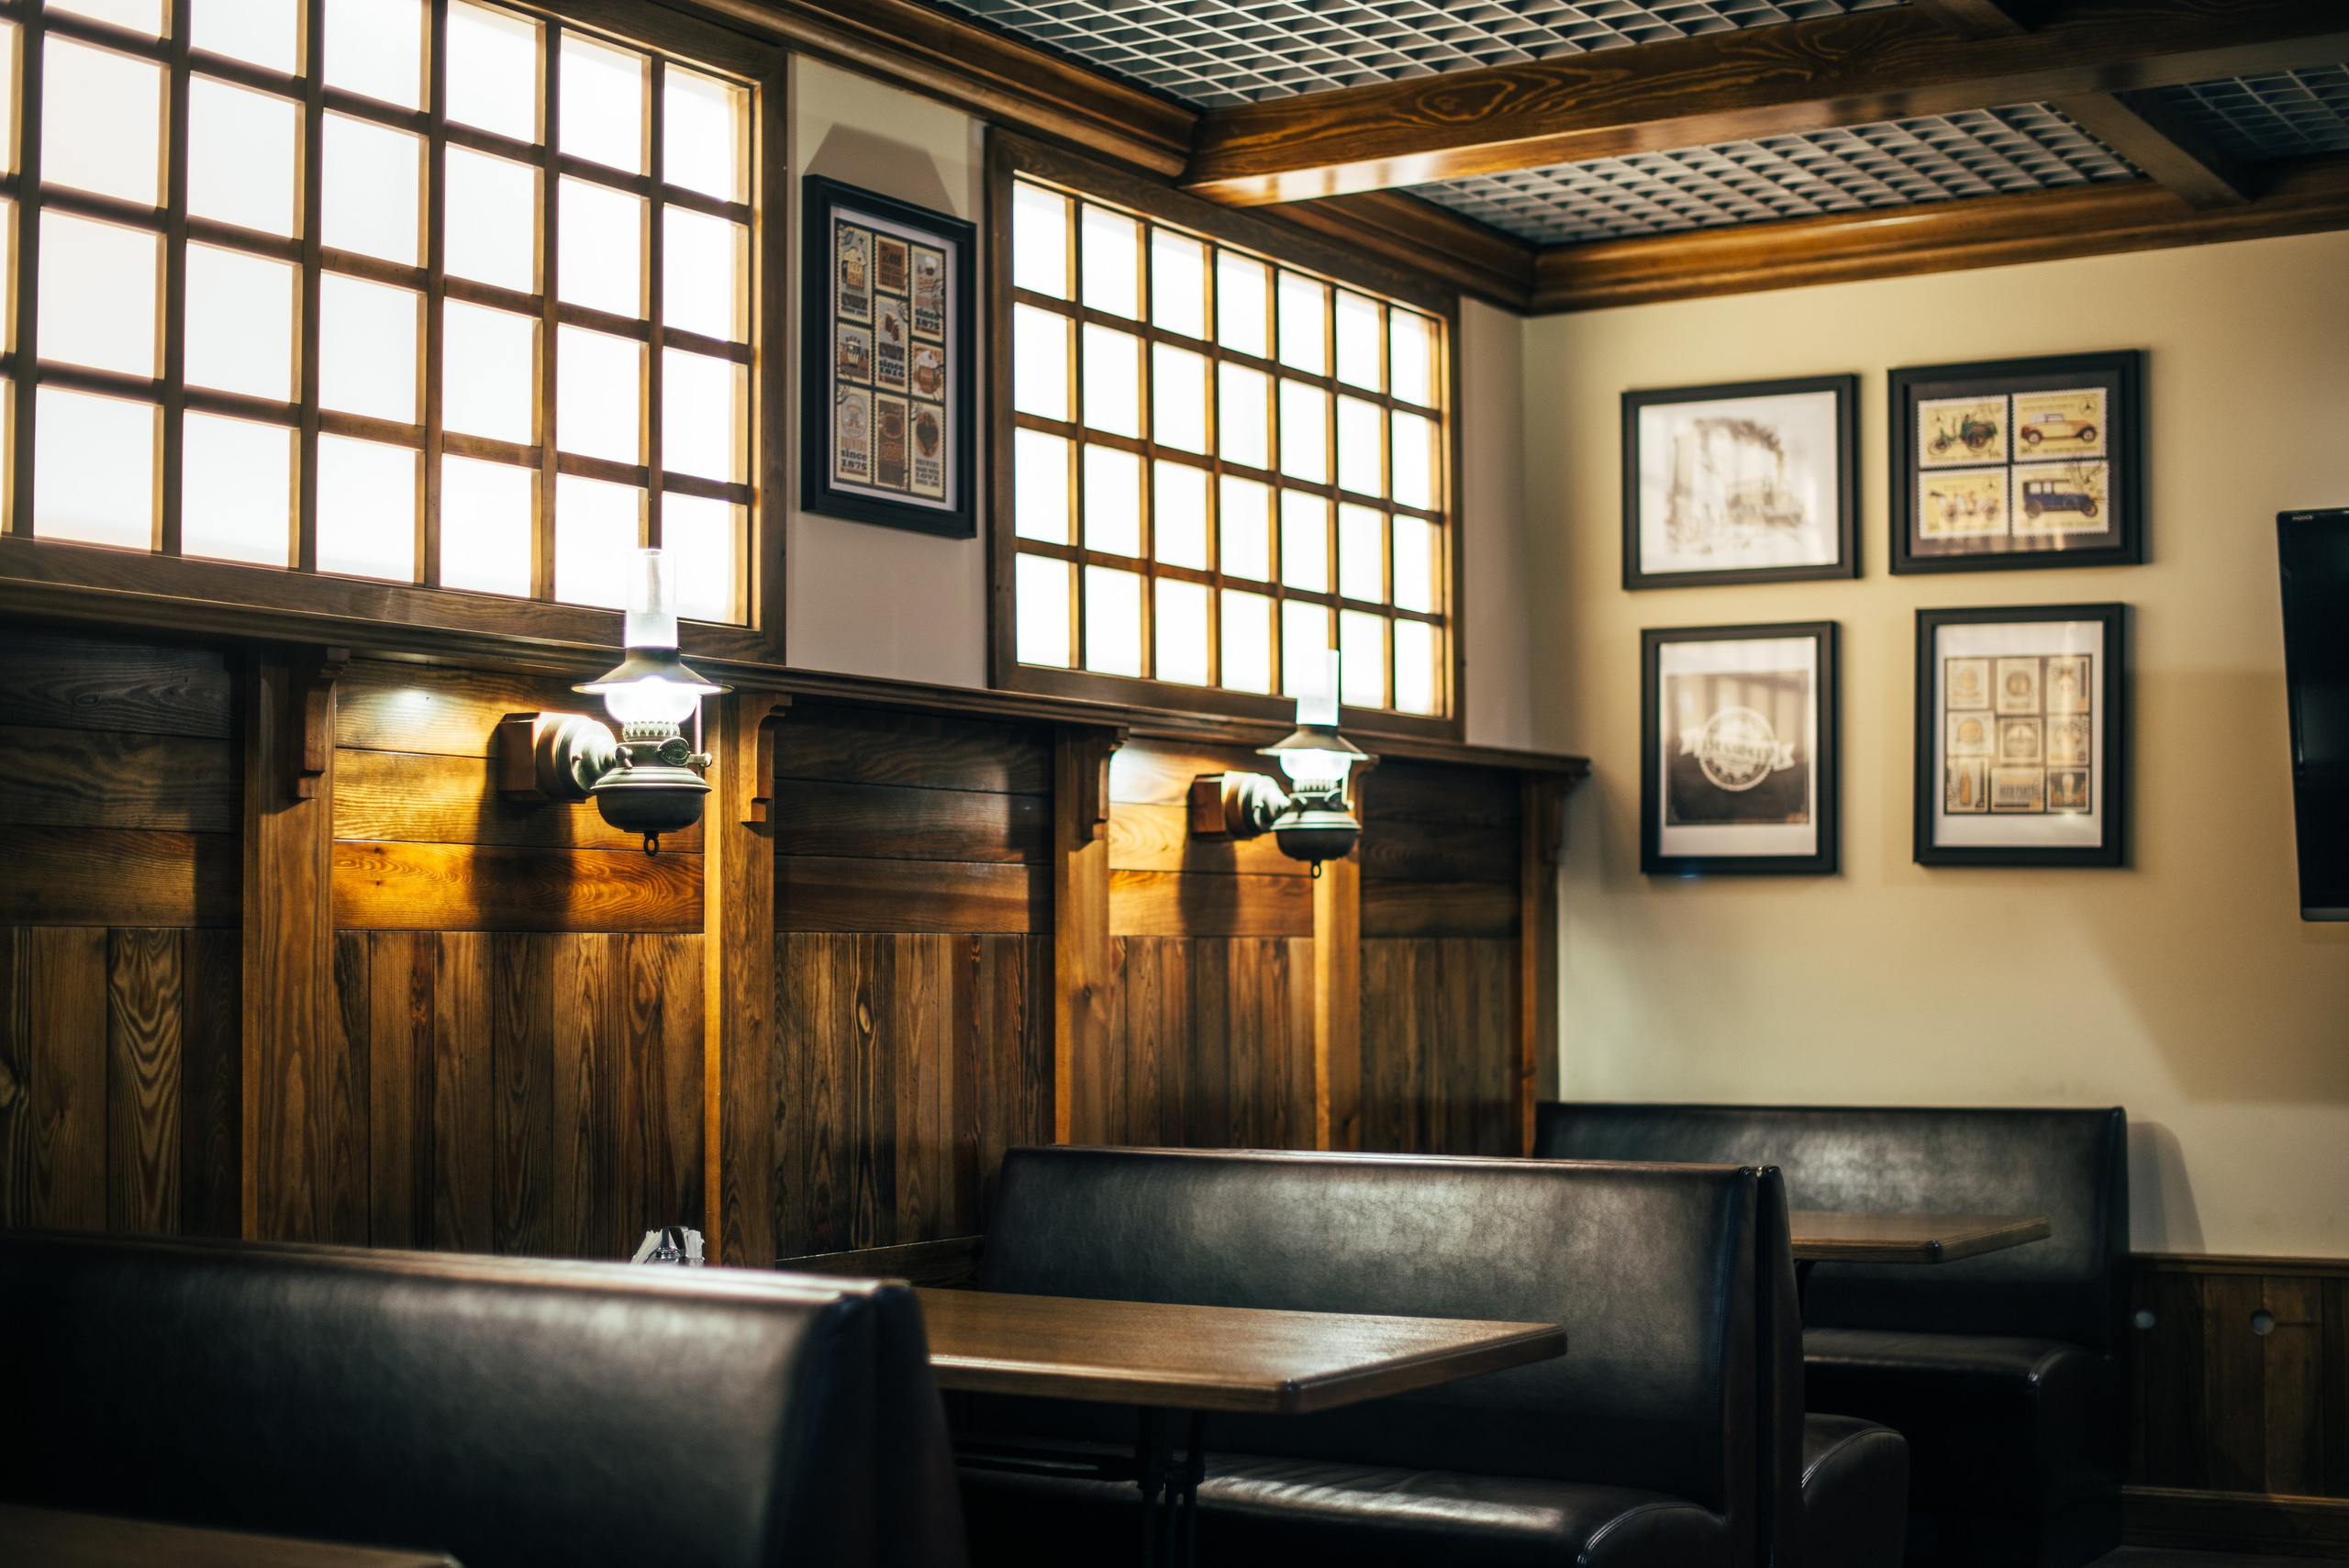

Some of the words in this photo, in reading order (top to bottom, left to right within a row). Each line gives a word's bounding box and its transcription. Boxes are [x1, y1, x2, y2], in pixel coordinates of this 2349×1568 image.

[915, 307, 941, 321] since
[879, 359, 905, 372] since
[841, 448, 867, 461] since
[841, 460, 867, 471] 1875
[916, 472, 940, 482] LOVE
